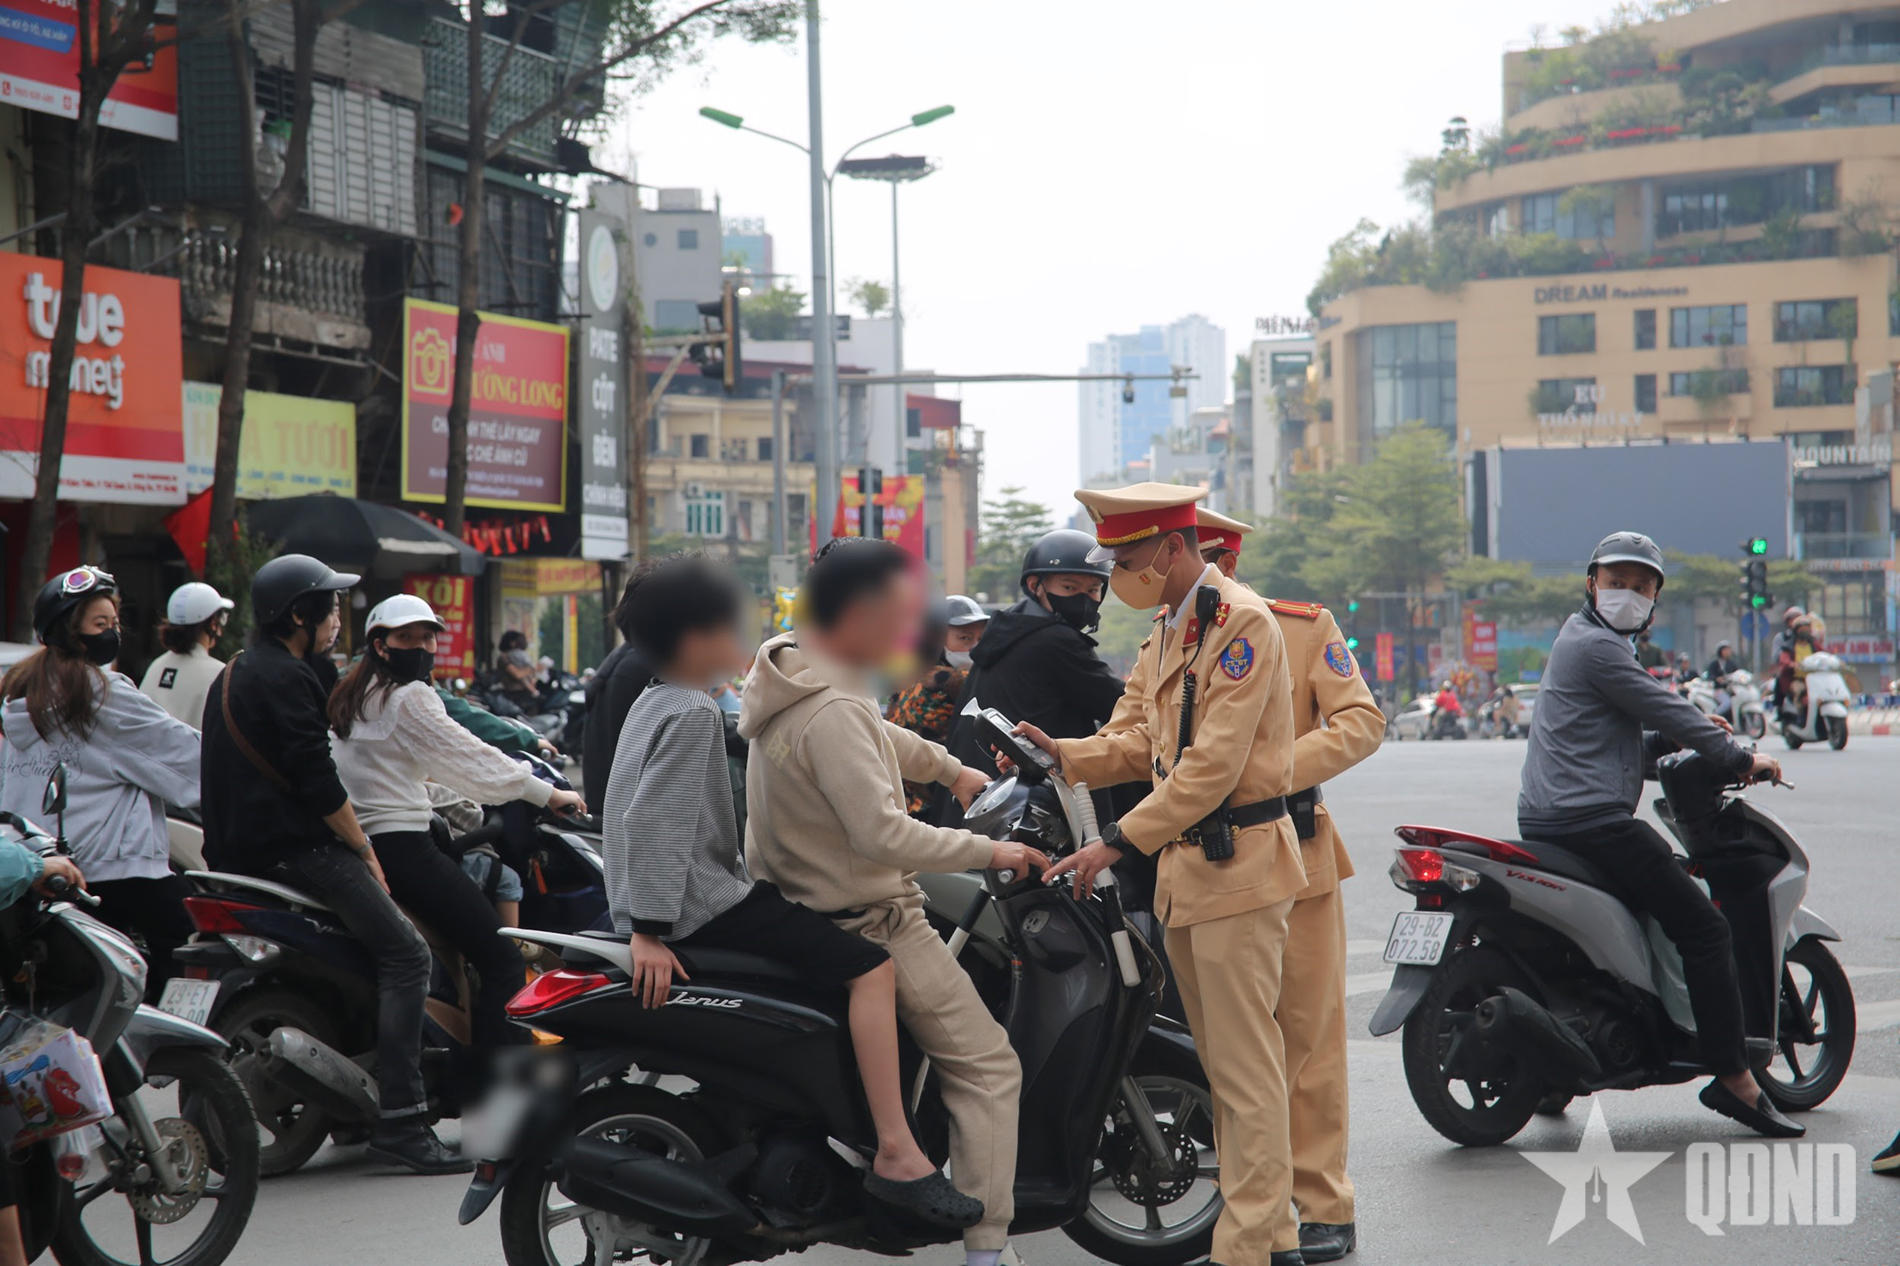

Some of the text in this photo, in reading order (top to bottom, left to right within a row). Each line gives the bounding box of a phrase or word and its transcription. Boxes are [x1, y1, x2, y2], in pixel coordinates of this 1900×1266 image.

[1533, 284, 1607, 303] DREAM
[25, 350, 125, 410] mney
[520, 378, 562, 410] LONG
[192, 411, 263, 463] HA
[412, 574, 465, 607] XÔI
[1400, 915, 1444, 939] 29-B2
[1388, 938, 1441, 961] 072.58
[666, 991, 743, 1009] Janus
